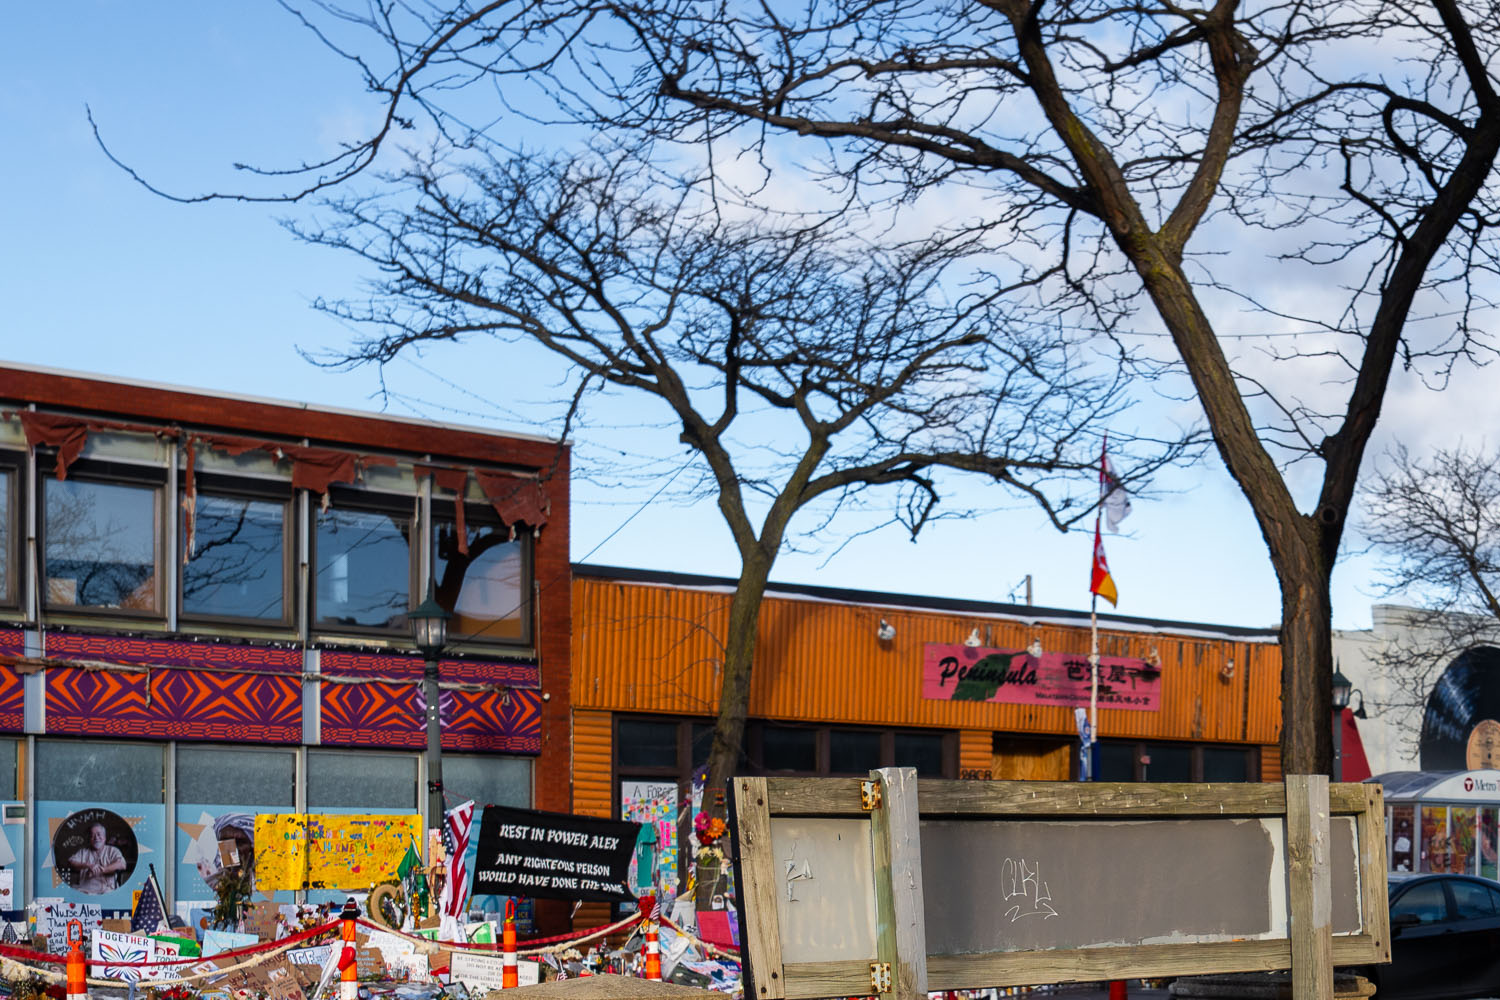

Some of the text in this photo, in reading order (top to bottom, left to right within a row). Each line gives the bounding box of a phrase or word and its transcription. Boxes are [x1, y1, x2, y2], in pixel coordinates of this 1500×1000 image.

[633, 785, 642, 798] A
[1475, 779, 1496, 791] Metro
[499, 824, 619, 850] REST IN POWER ALEX
[495, 853, 610, 877] ANY RIGHTEOUS PERSON
[478, 871, 625, 894] WOULD HAVE DONE THE SAME
[50, 904, 101, 917] Nurse Alex
[99, 930, 149, 947] TOGETHER
